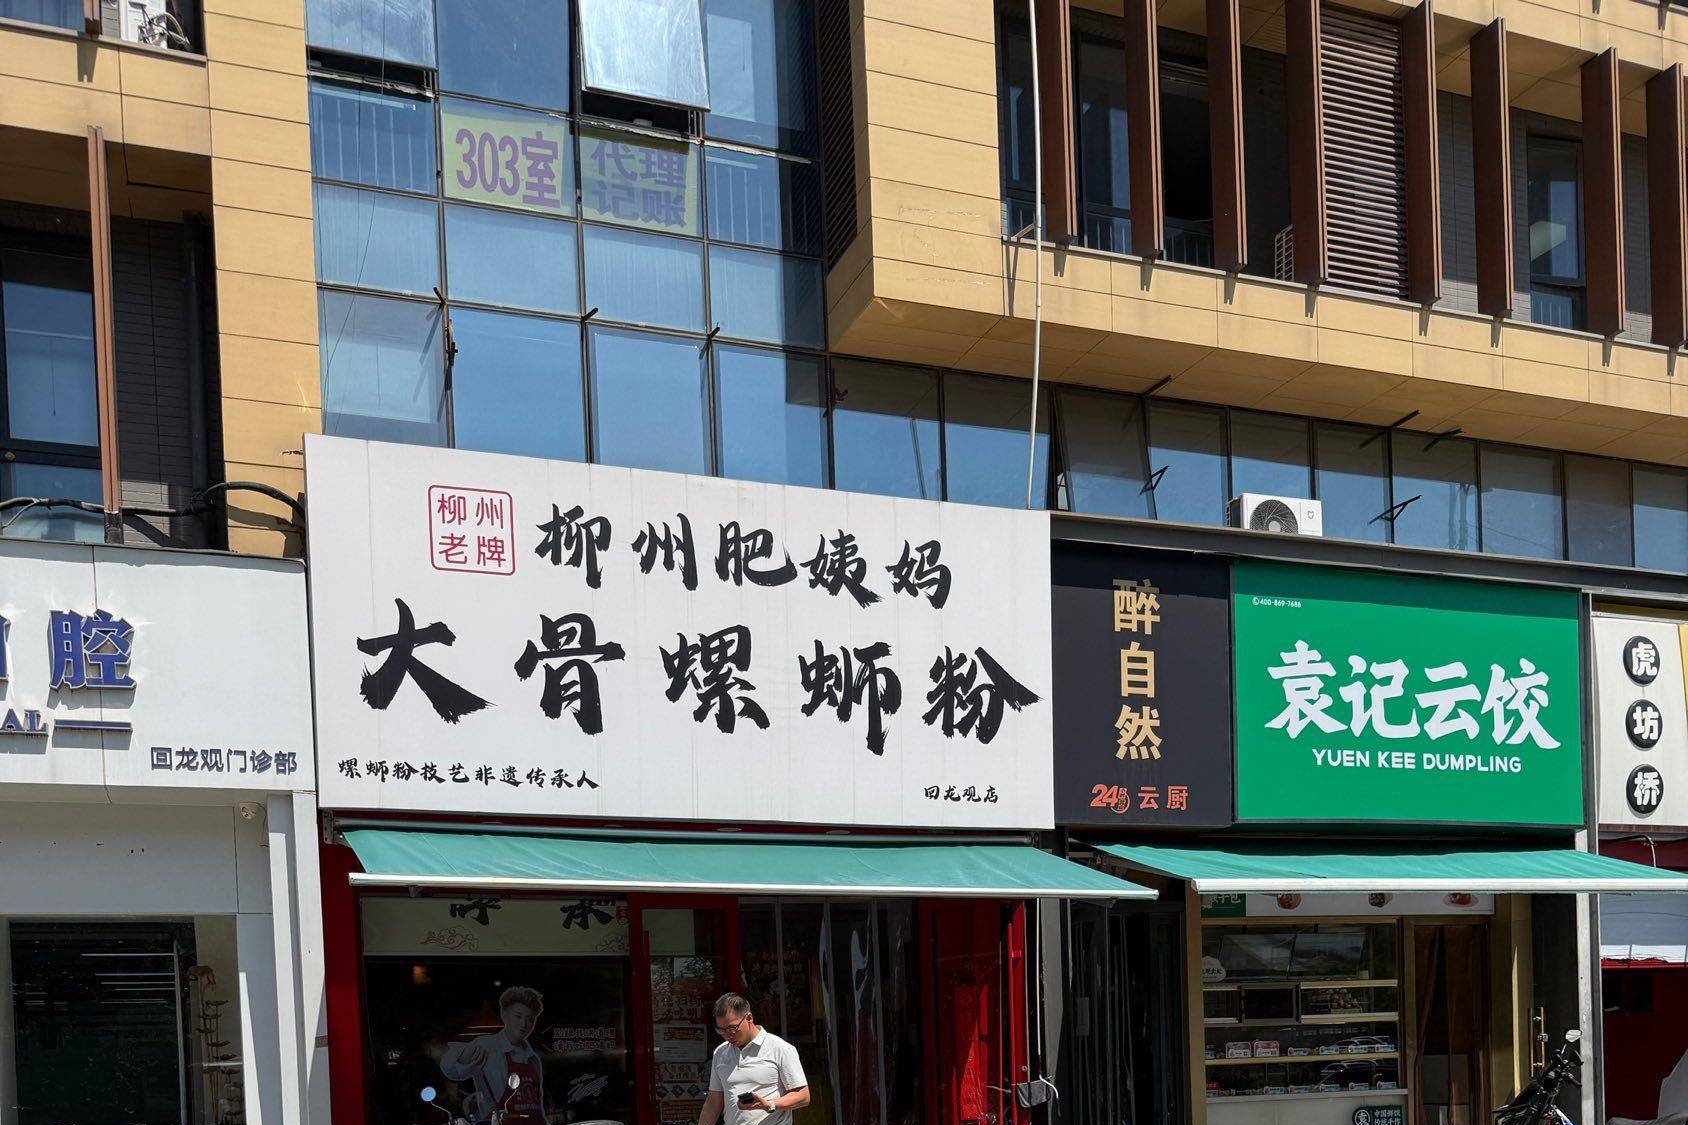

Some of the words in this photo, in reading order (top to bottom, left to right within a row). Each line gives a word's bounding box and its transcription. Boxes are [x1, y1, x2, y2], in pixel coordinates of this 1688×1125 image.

[456, 129, 561, 209] 303室
[592, 141, 687, 188] 代理
[595, 180, 687, 228] 记账
[437, 493, 504, 529] 柳州
[438, 533, 506, 567] 老牌
[535, 503, 953, 610] 柳州肥姨妈
[0, 608, 137, 690] 腔
[1112, 578, 1163, 761] 醉自然
[356, 598, 1044, 757] 大骨螺蛳粉
[1264, 639, 1562, 750] 袁记云饺
[1631, 641, 1661, 806] 虎坊桥
[150, 746, 298, 775] 回龙观门诊部
[337, 757, 600, 790] 螺蛳粉技艺非遗传承人
[1312, 748, 1370, 768] YUEN
[1377, 750, 1416, 770] KEE
[1422, 752, 1522, 774] DUMPLING
[923, 784, 999, 804] 回龙观店
[1137, 785, 1188, 811] 云厨
